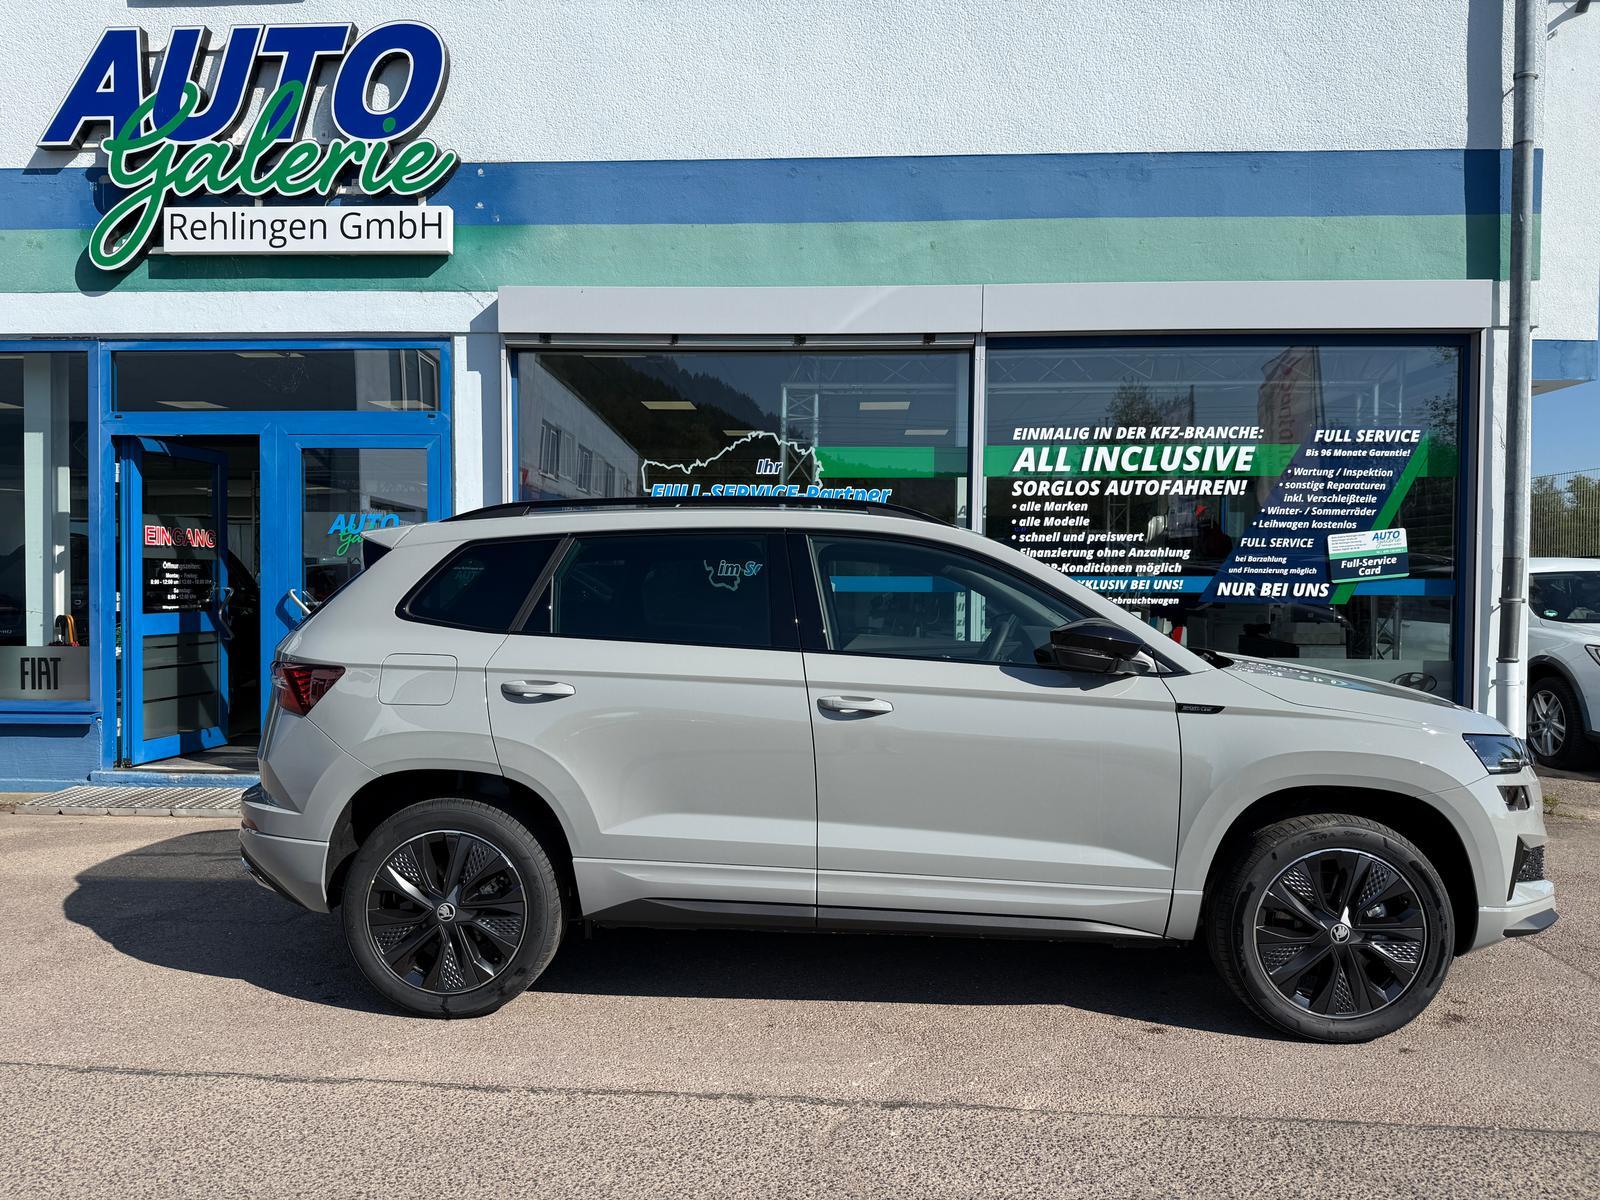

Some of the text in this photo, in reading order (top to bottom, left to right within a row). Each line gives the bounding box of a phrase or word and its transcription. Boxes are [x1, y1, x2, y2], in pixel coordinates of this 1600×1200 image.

[37, 19, 447, 147] AUTO
[89, 80, 457, 271] Galerie
[169, 211, 443, 248] Rehlingen GmbH
[1012, 426, 1265, 441] EINMALIG IN DER KFZ-BRANCHE:
[1314, 429, 1421, 443] FULL SERVICE
[1012, 445, 1256, 472] ALL INCLUSIVE
[1305, 448, 1411, 457] Bis 96 Monate Garantie!
[755, 458, 784, 475] Ihr
[1293, 467, 1393, 479] Wartung / Inspektion
[1011, 479, 1248, 496] SORGLOS AUTOFAHREN!
[1285, 481, 1386, 491] sonstige Reparaturen
[1283, 494, 1377, 504] inkl. Verschleißteile
[1019, 501, 1088, 512] alle Marken
[1267, 506, 1377, 516] Winter- / Sommerräder
[327, 513, 400, 535] AUTO
[1018, 516, 1090, 527] alle Modelle
[1258, 519, 1357, 530] Leihwagen kostenlos
[144, 525, 216, 548] EINGANG
[1018, 531, 1144, 545] schnell und preiswert
[1372, 530, 1400, 541] AUTO
[1240, 538, 1314, 548] FULL SERVICE
[1096, 547, 1125, 558] ohne
[1128, 547, 1191, 560] Anzahlung
[1234, 555, 1287, 564] bei Barzahlung
[718, 559, 740, 576] im
[1135, 562, 1182, 575] möglich
[1340, 556, 1398, 569] Full-Service
[1243, 567, 1288, 576] Finanzierung
[1289, 567, 1317, 576] möglich
[1358, 566, 1381, 576] Card
[1130, 579, 1151, 590] BEI
[1153, 579, 1184, 590] UNS!
[1216, 582, 1330, 597] NUR BEI UNS
[20, 657, 62, 690] FIAT
